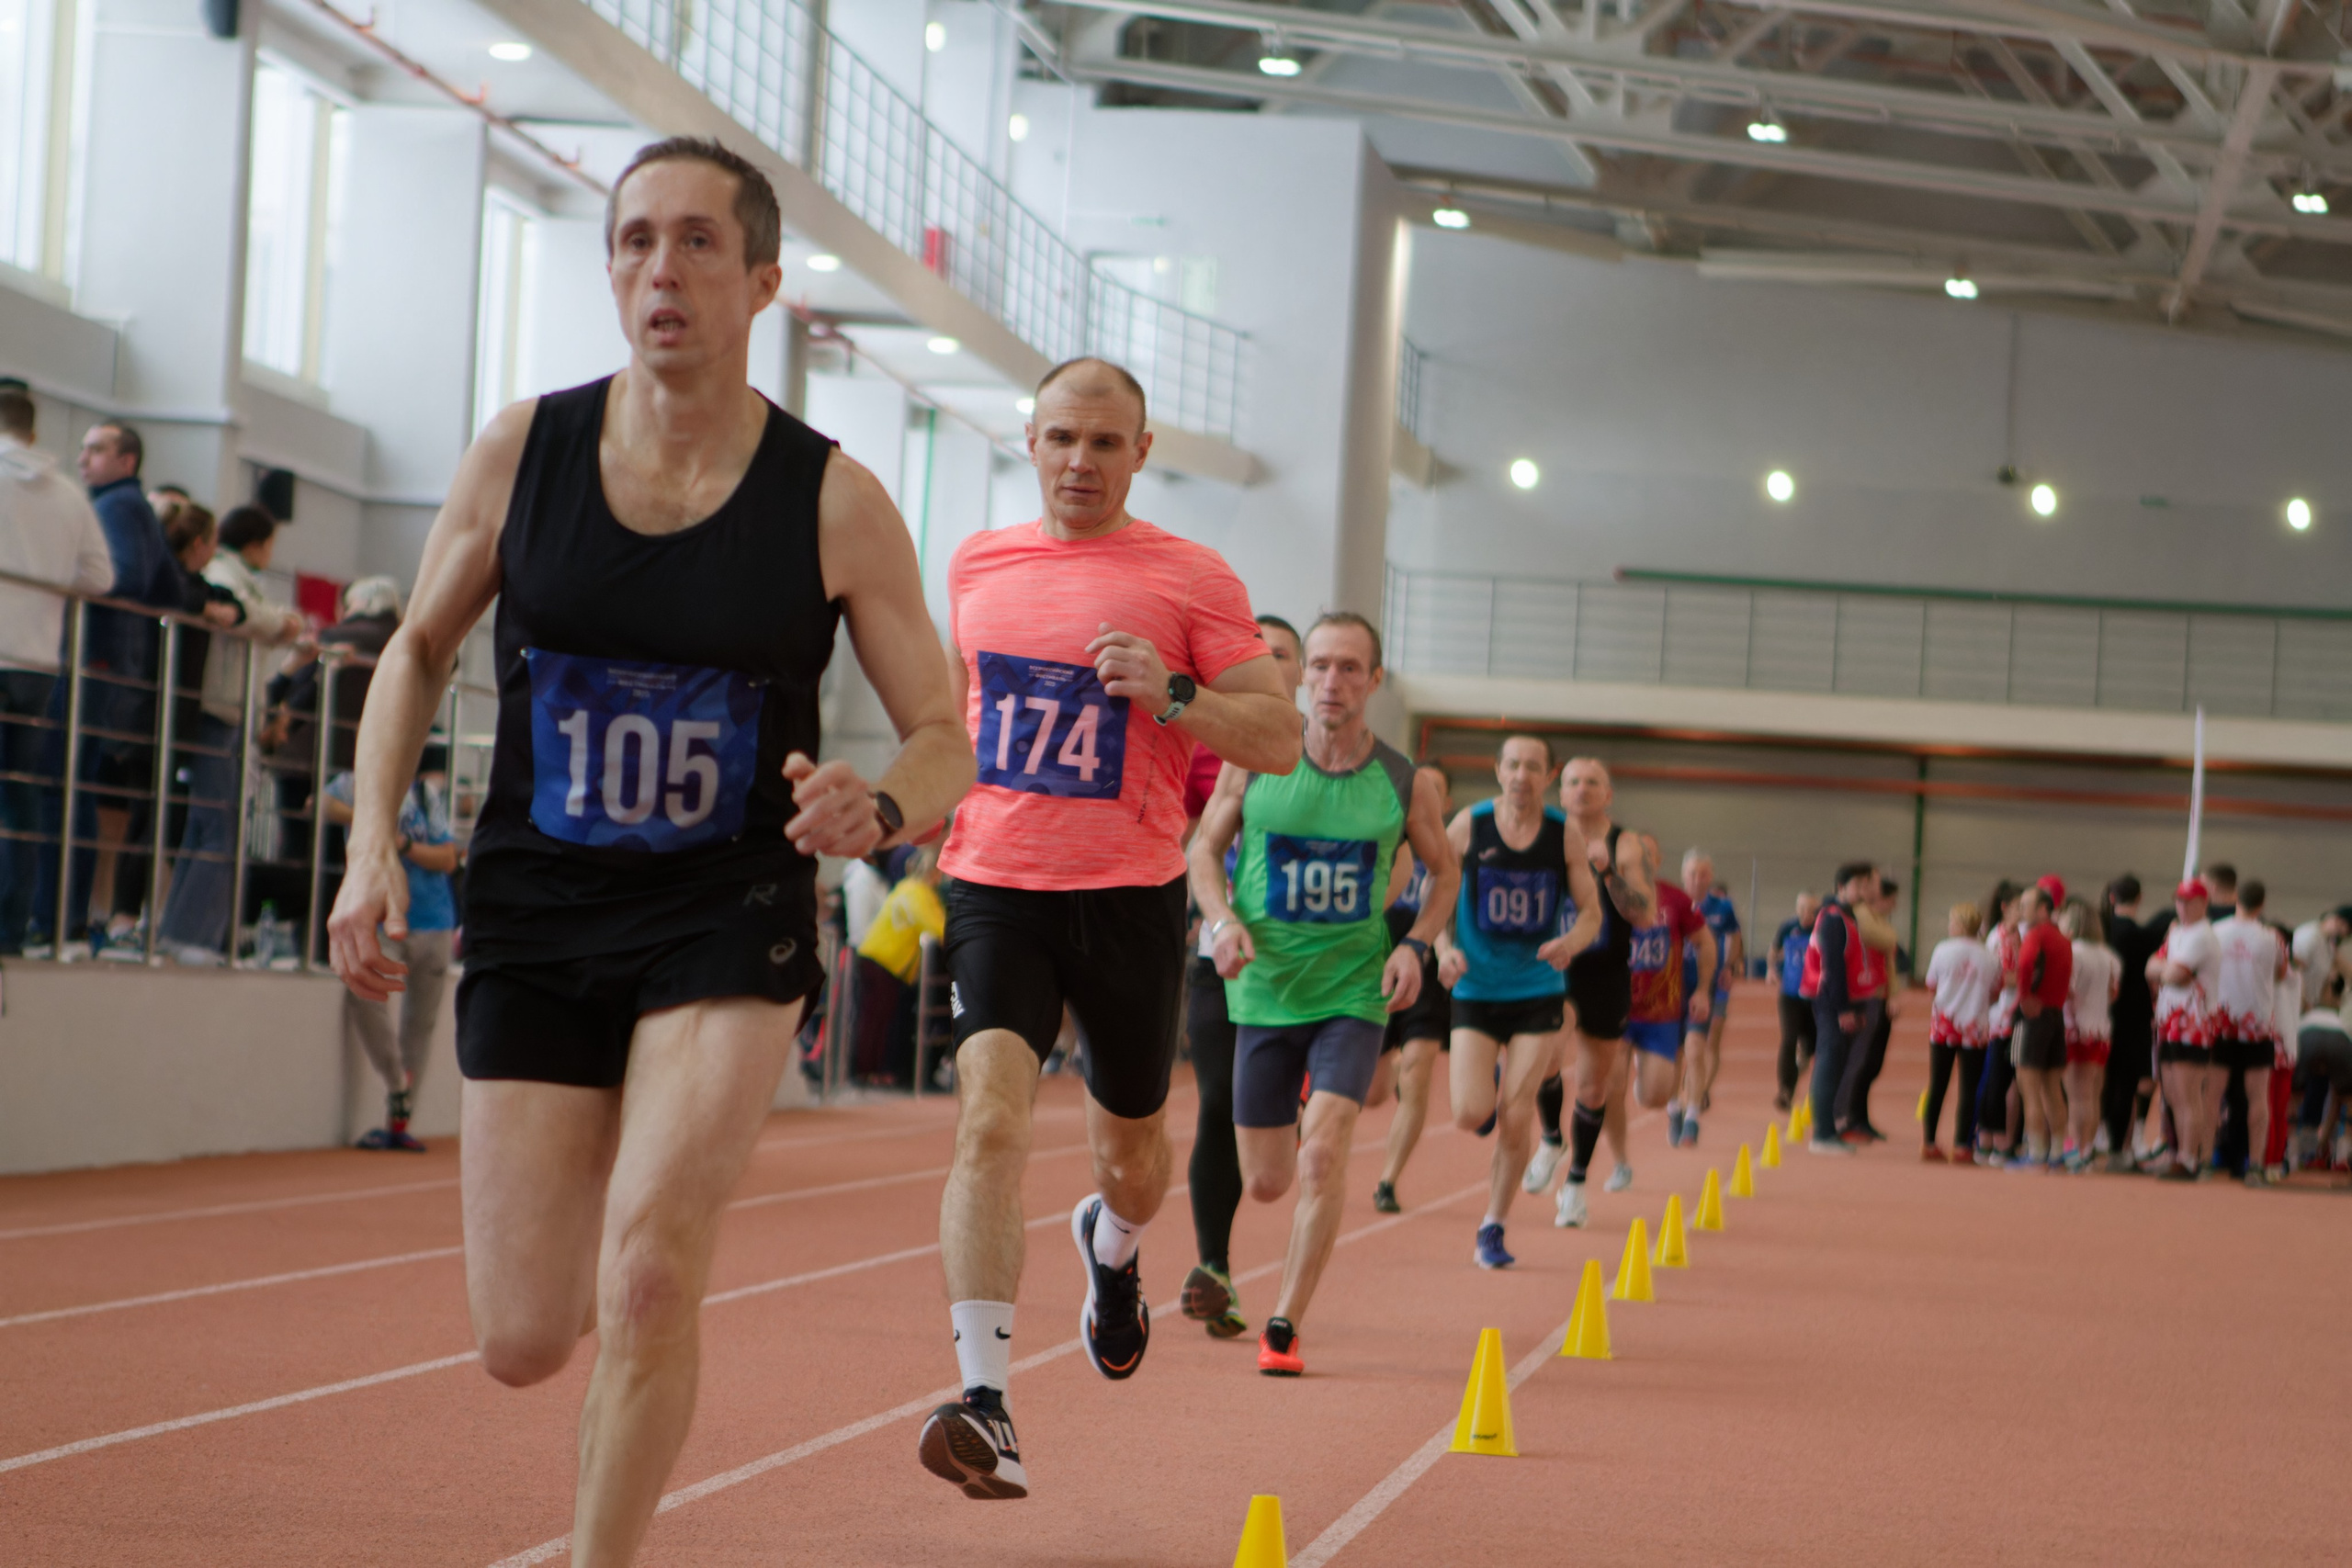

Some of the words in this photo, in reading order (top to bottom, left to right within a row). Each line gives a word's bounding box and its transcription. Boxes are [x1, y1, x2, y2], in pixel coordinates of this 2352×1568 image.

[559, 710, 719, 829] 105
[996, 694, 1100, 782] 174
[1281, 859, 1359, 914] 195
[1488, 886, 1545, 925] 091
